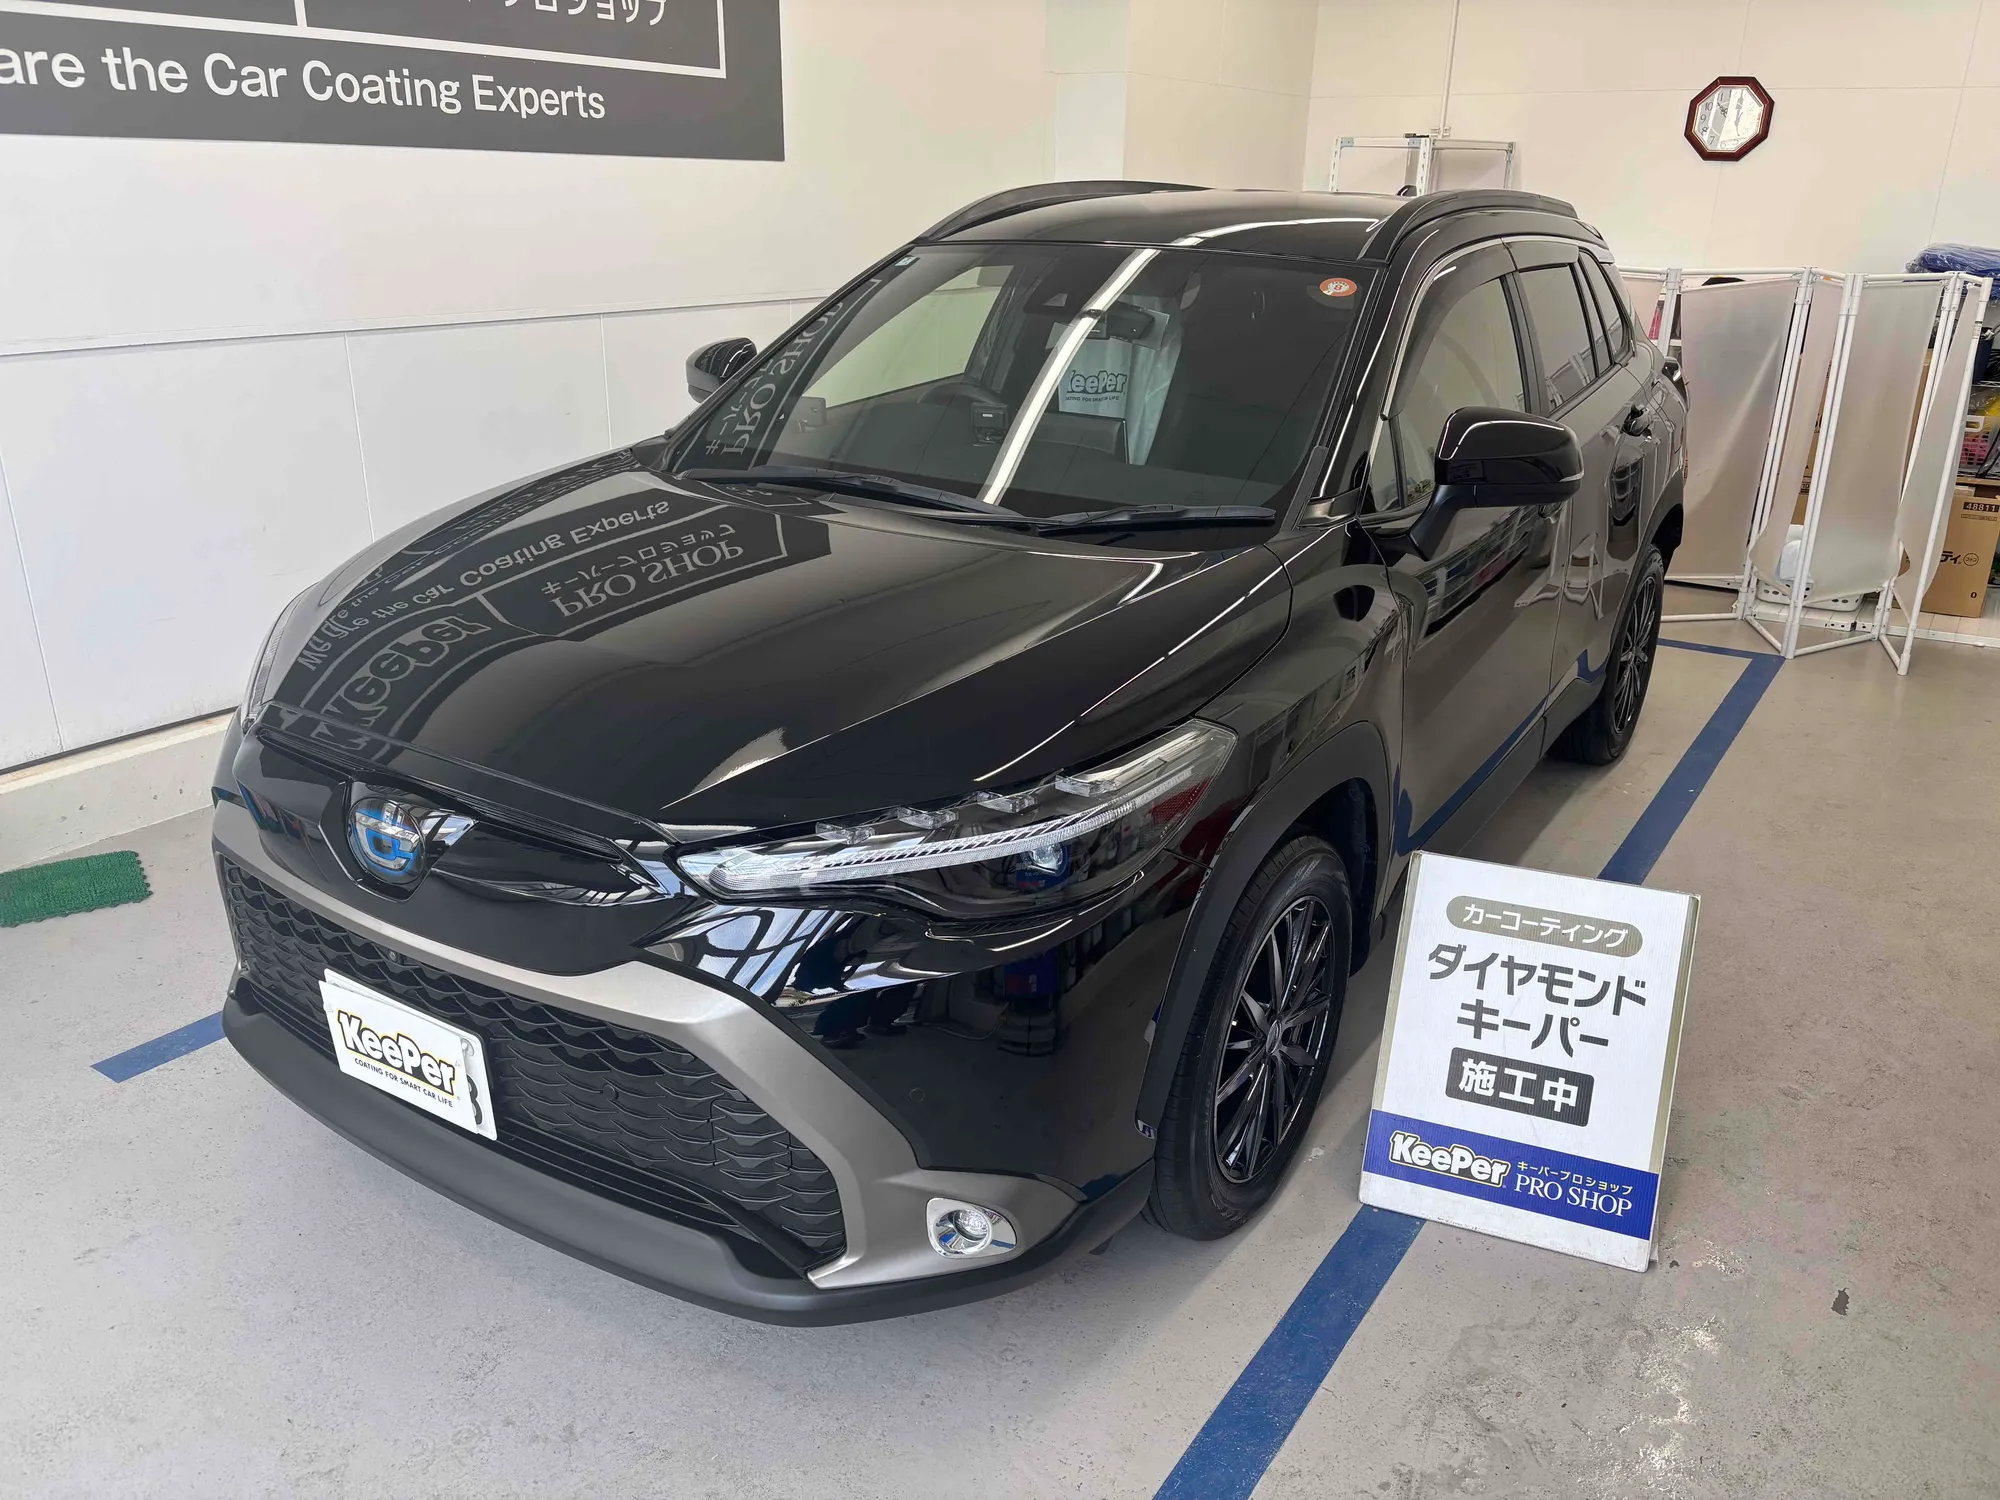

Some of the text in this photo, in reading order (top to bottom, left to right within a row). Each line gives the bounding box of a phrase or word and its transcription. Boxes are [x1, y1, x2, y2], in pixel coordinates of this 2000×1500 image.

[0, 47, 606, 119] are the Car Coating Experts
[1067, 370, 1127, 394] eePer
[1966, 503, 1996, 512] 48811
[1463, 904, 1628, 948] カーコーティング
[1428, 943, 1646, 1016] ダイヤモンド
[337, 1009, 455, 1096] KeePer
[1457, 999, 1609, 1058] キーパー
[354, 1058, 453, 1107] COATING FOR SMART CAR LIFE
[1459, 1058, 1579, 1113] 施工中
[1389, 1131, 1511, 1188] KeePer
[1517, 1161, 1633, 1196] キーパープロショップ
[1513, 1173, 1632, 1217] PRO SHOP
